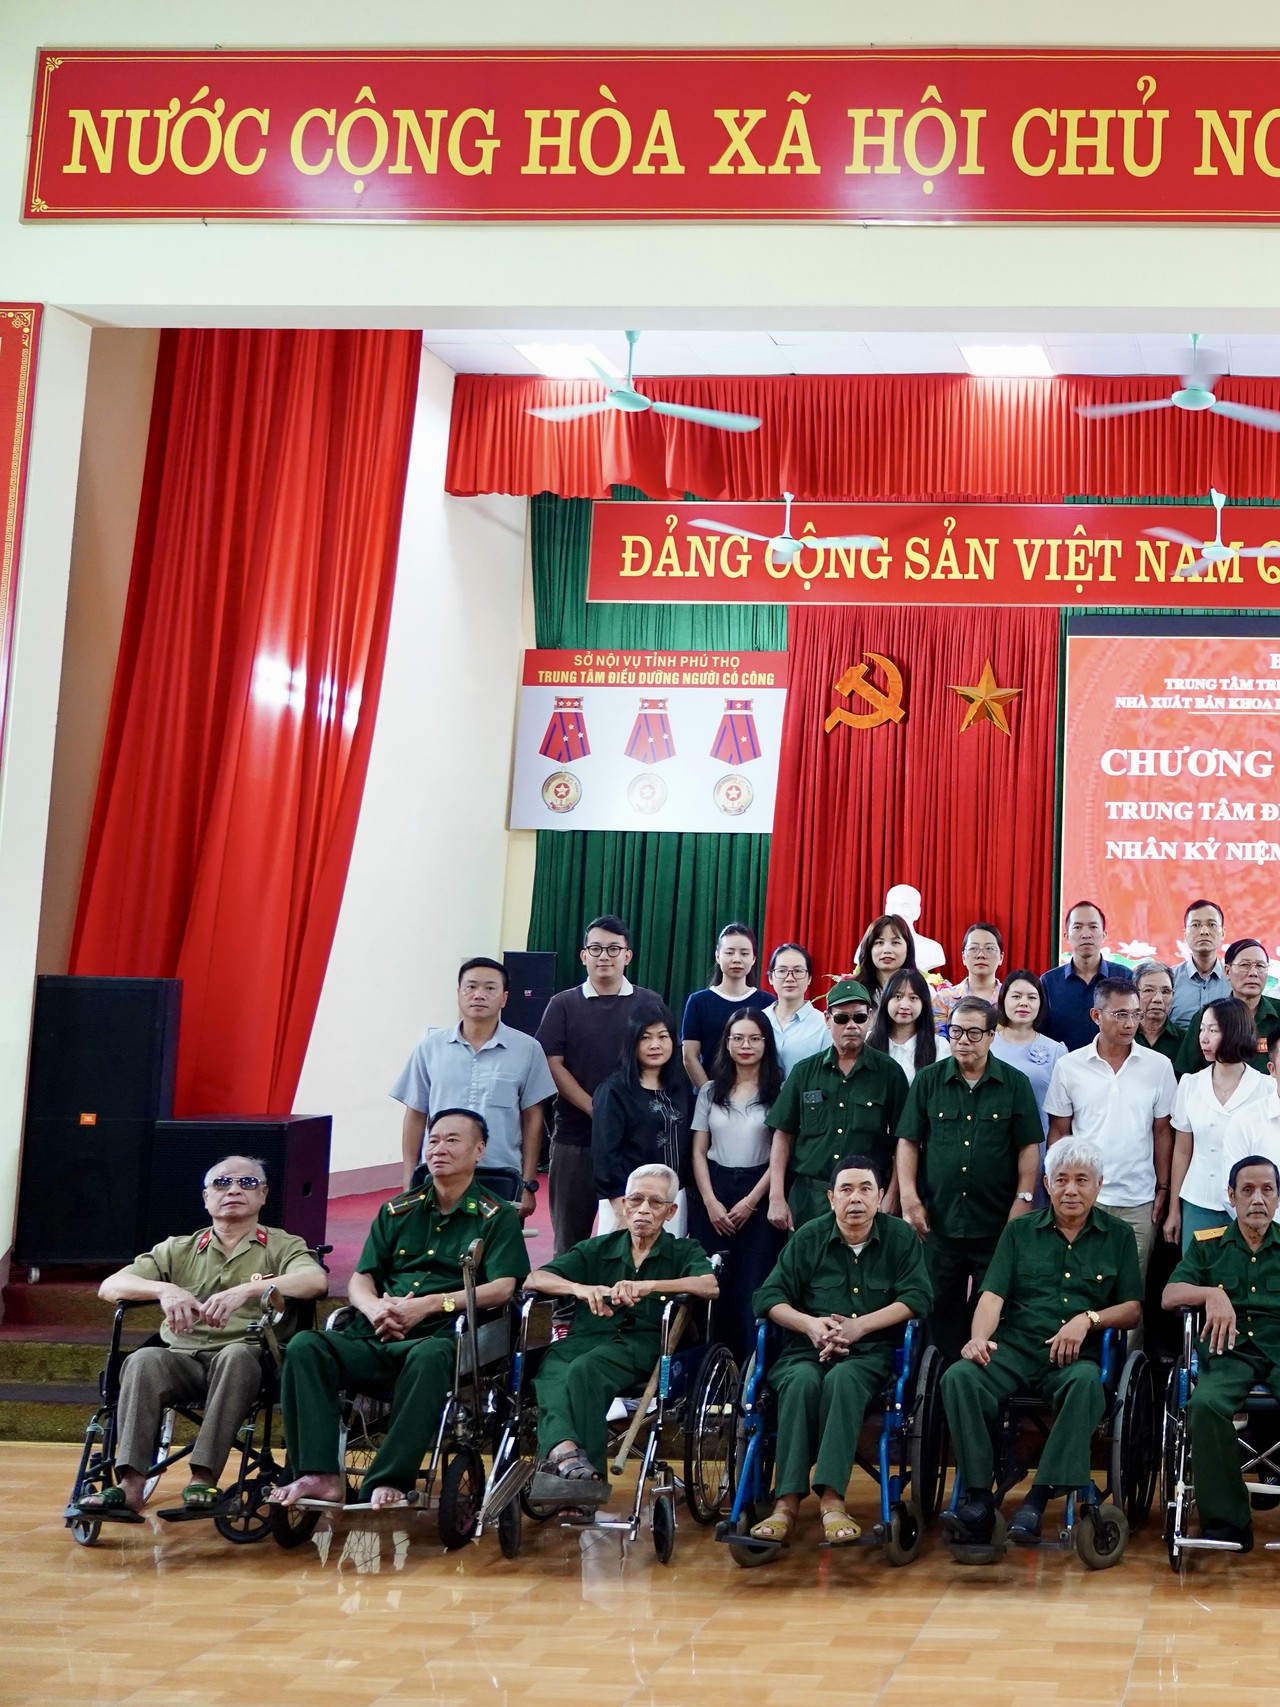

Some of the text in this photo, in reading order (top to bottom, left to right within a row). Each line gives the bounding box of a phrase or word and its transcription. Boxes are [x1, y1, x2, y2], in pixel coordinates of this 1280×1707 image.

[63, 86, 269, 175] NƯỚC
[290, 86, 500, 193] CỘNG
[521, 85, 685, 175] HÒA
[709, 91, 821, 174] XÃ
[844, 86, 986, 194] HỘI
[1012, 76, 1169, 177] CHỦ
[620, 515, 752, 578] ĐẢNG
[765, 522, 893, 590] CỘNG
[905, 517, 999, 580] SẢN
[1013, 525, 1122, 593] VIỆT
[1135, 538, 1246, 582] NAM
[575, 652, 740, 669] SỞ NỘI VỤ TỈNH PHÚ THỌ
[539, 666, 774, 685] TRUNG TÂM ĐIỀU DƯỠNG NGƯỜI CÓ CÔNG
[1165, 679, 1217, 690] TRUNG
[1219, 676, 1254, 690] TÂM
[1115, 694, 1148, 708] NHÀ
[1228, 698, 1273, 709] KHOA
[1101, 747, 1274, 777] CHƯƠNG
[1105, 802, 1193, 820] TRUNG
[1198, 798, 1254, 820] TÂM
[1106, 837, 1178, 859] NHÂN
[1183, 837, 1220, 860] KỶ
